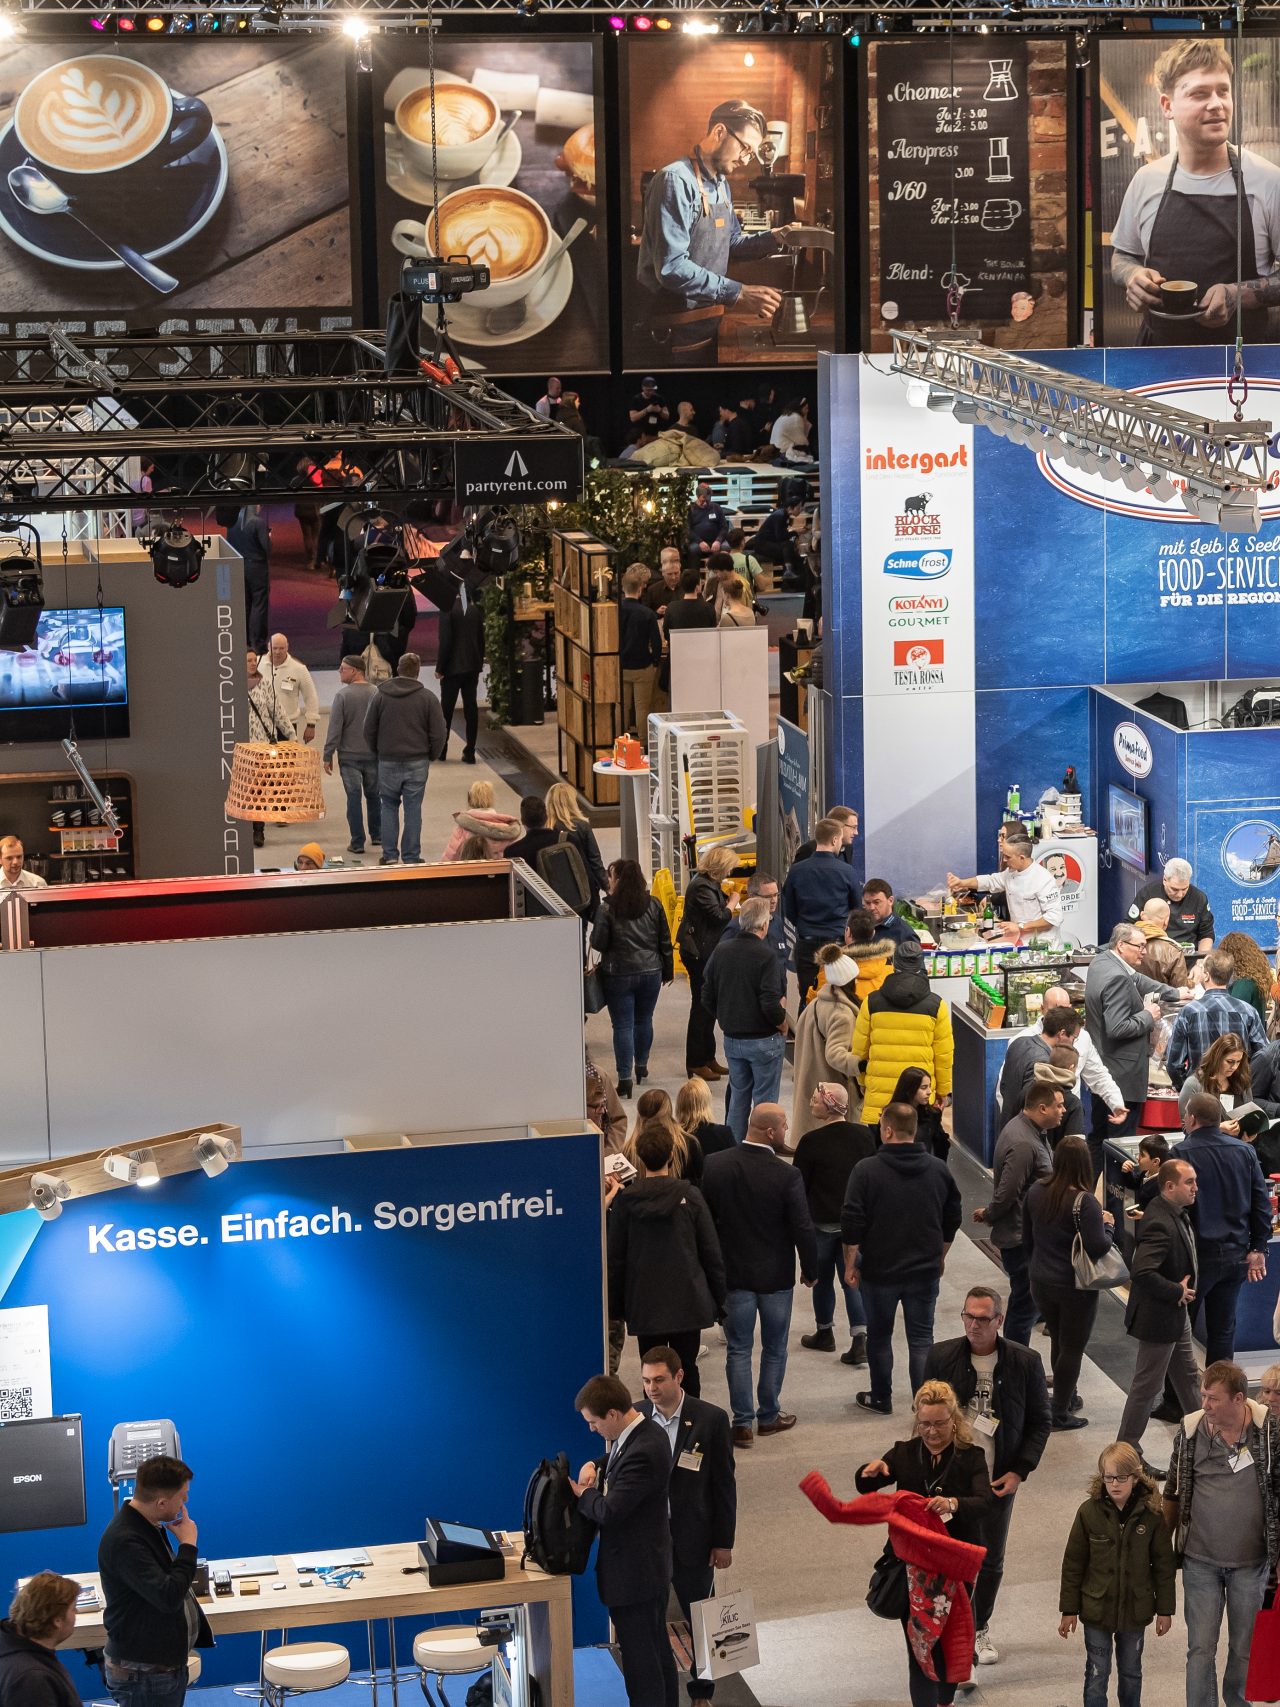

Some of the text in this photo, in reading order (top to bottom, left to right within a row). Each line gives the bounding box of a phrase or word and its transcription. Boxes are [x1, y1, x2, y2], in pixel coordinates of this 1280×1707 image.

[892, 138, 959, 165] Aeropress
[955, 167, 974, 178] 3.00
[893, 180, 927, 200] V60
[0, 320, 129, 379] FEE
[866, 444, 967, 474] intergast
[466, 479, 567, 495] partyrent.com
[895, 515, 941, 525] BLOCK
[895, 525, 941, 536] HOUSE
[1159, 540, 1186, 555] mit
[1190, 537, 1224, 556] Leib
[1229, 538, 1239, 553] &
[895, 594, 943, 610] KOTÁNYI
[1160, 593, 1192, 607] FÜR
[1197, 593, 1223, 605] DIE
[889, 616, 950, 627] GOURMET
[894, 669, 944, 686] TESTA ROSSA
[88, 1190, 563, 1254] Kasse. Einfach. Sorgenfrei.
[13, 1474, 42, 1484] EPSON
